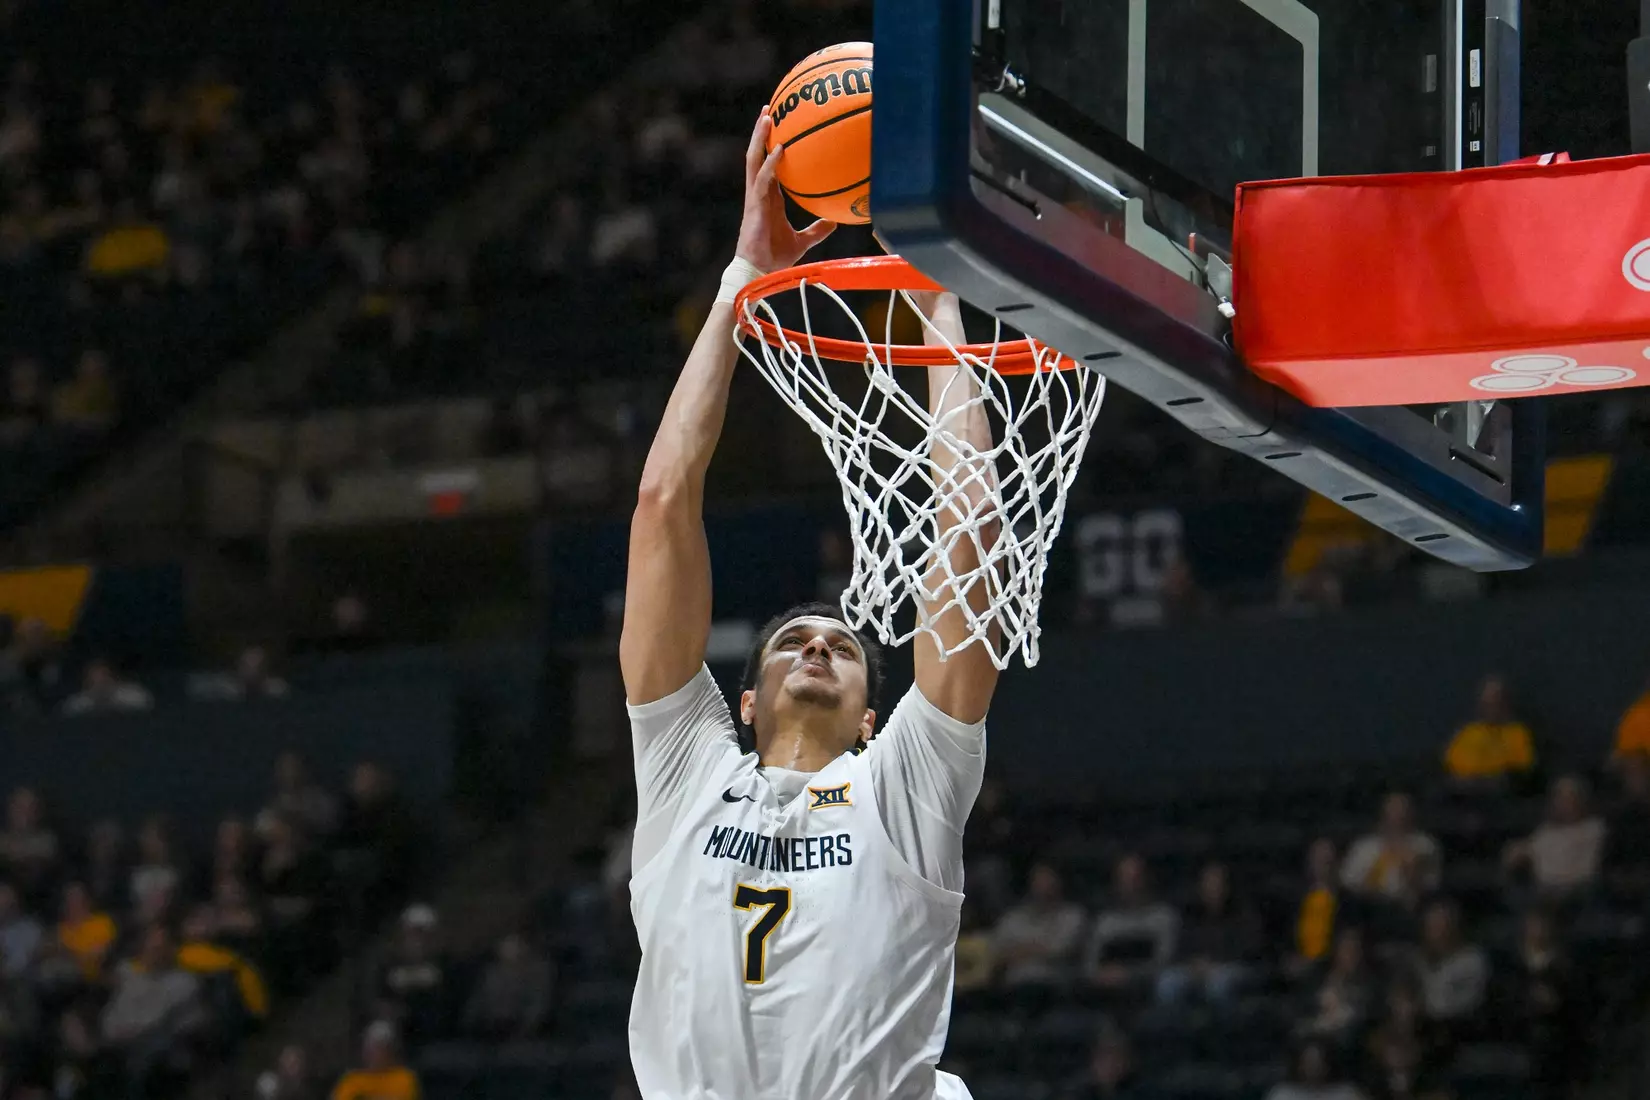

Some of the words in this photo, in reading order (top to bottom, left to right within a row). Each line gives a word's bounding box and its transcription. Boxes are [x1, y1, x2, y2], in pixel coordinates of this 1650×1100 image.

[772, 67, 873, 127] Wilson
[703, 825, 853, 872] MOUNTINEERS
[733, 883, 792, 984] 7
